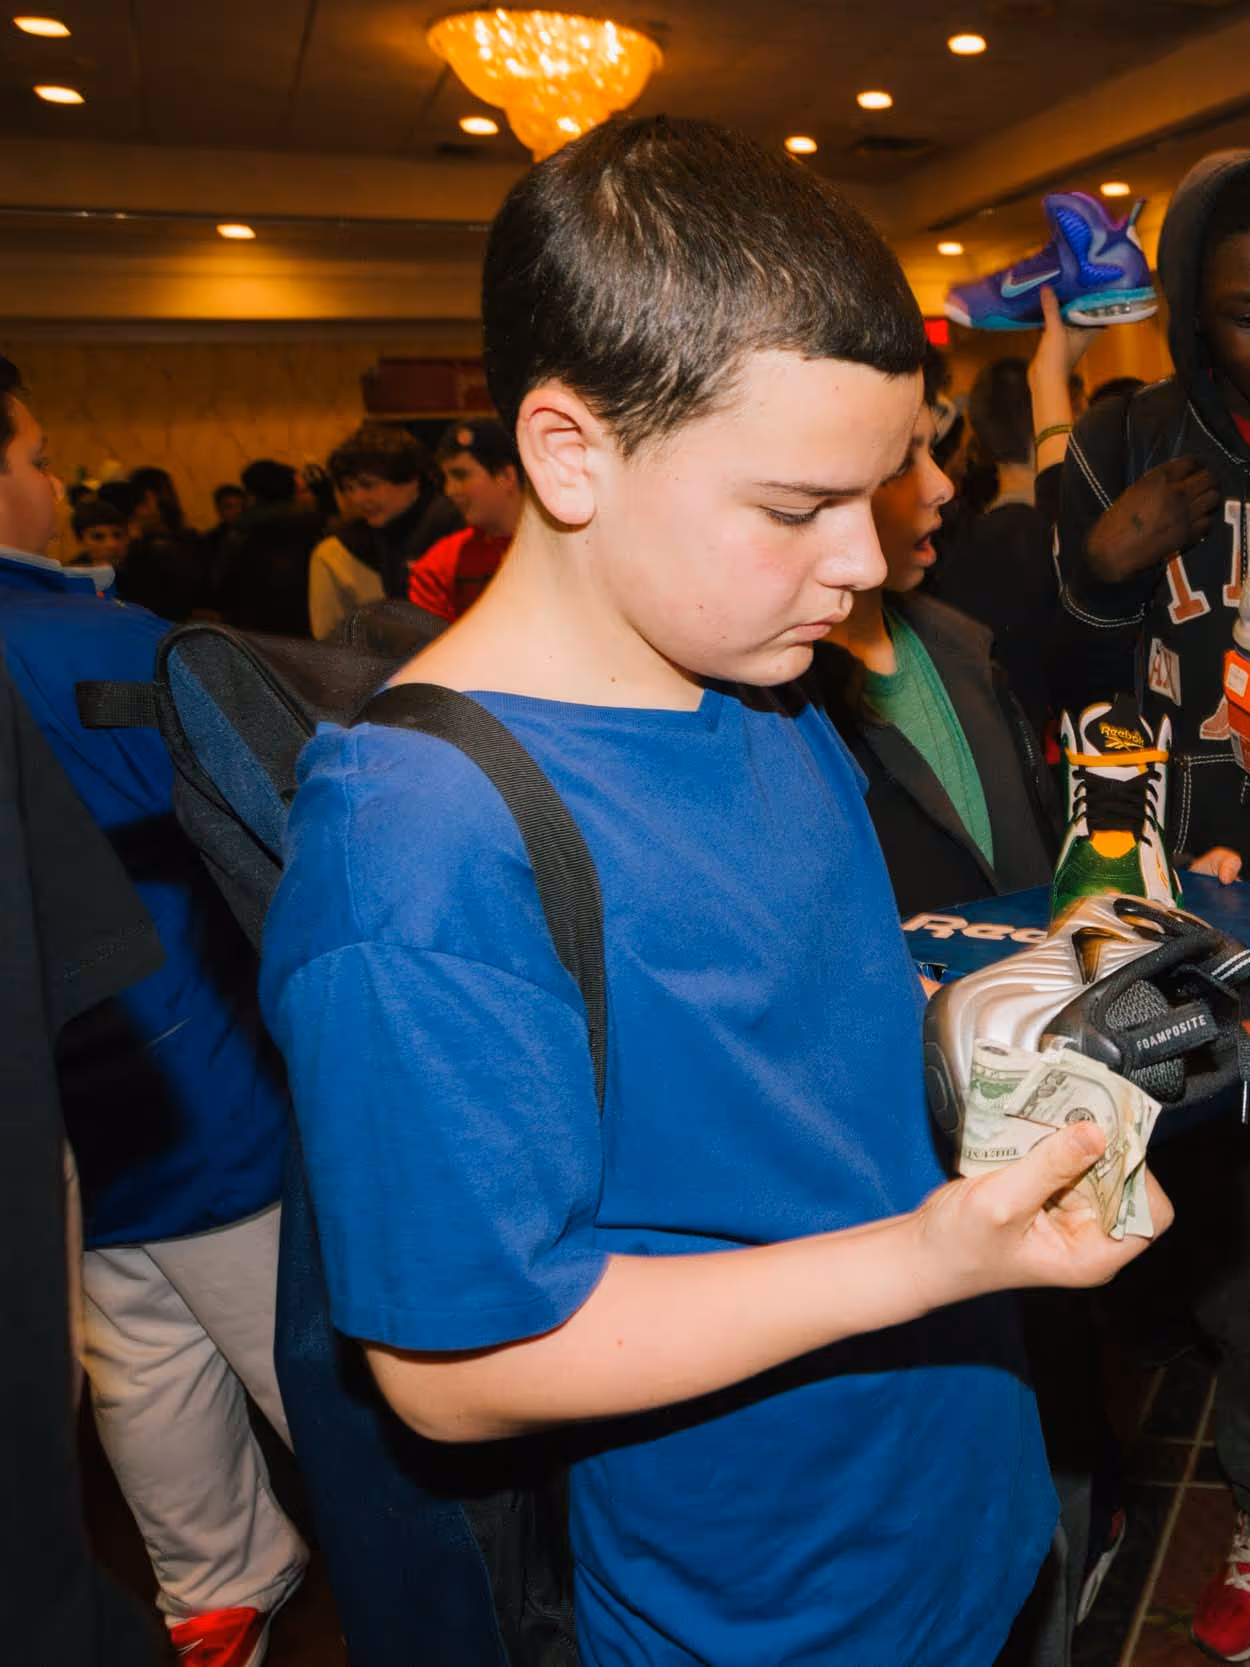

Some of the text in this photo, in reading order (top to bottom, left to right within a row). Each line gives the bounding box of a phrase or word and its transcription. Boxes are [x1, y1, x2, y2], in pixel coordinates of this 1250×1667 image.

[1100, 724, 1145, 746] Reebok
[901, 912, 1049, 944] Ree
[1136, 1014, 1207, 1051] FOAMPOSITE
